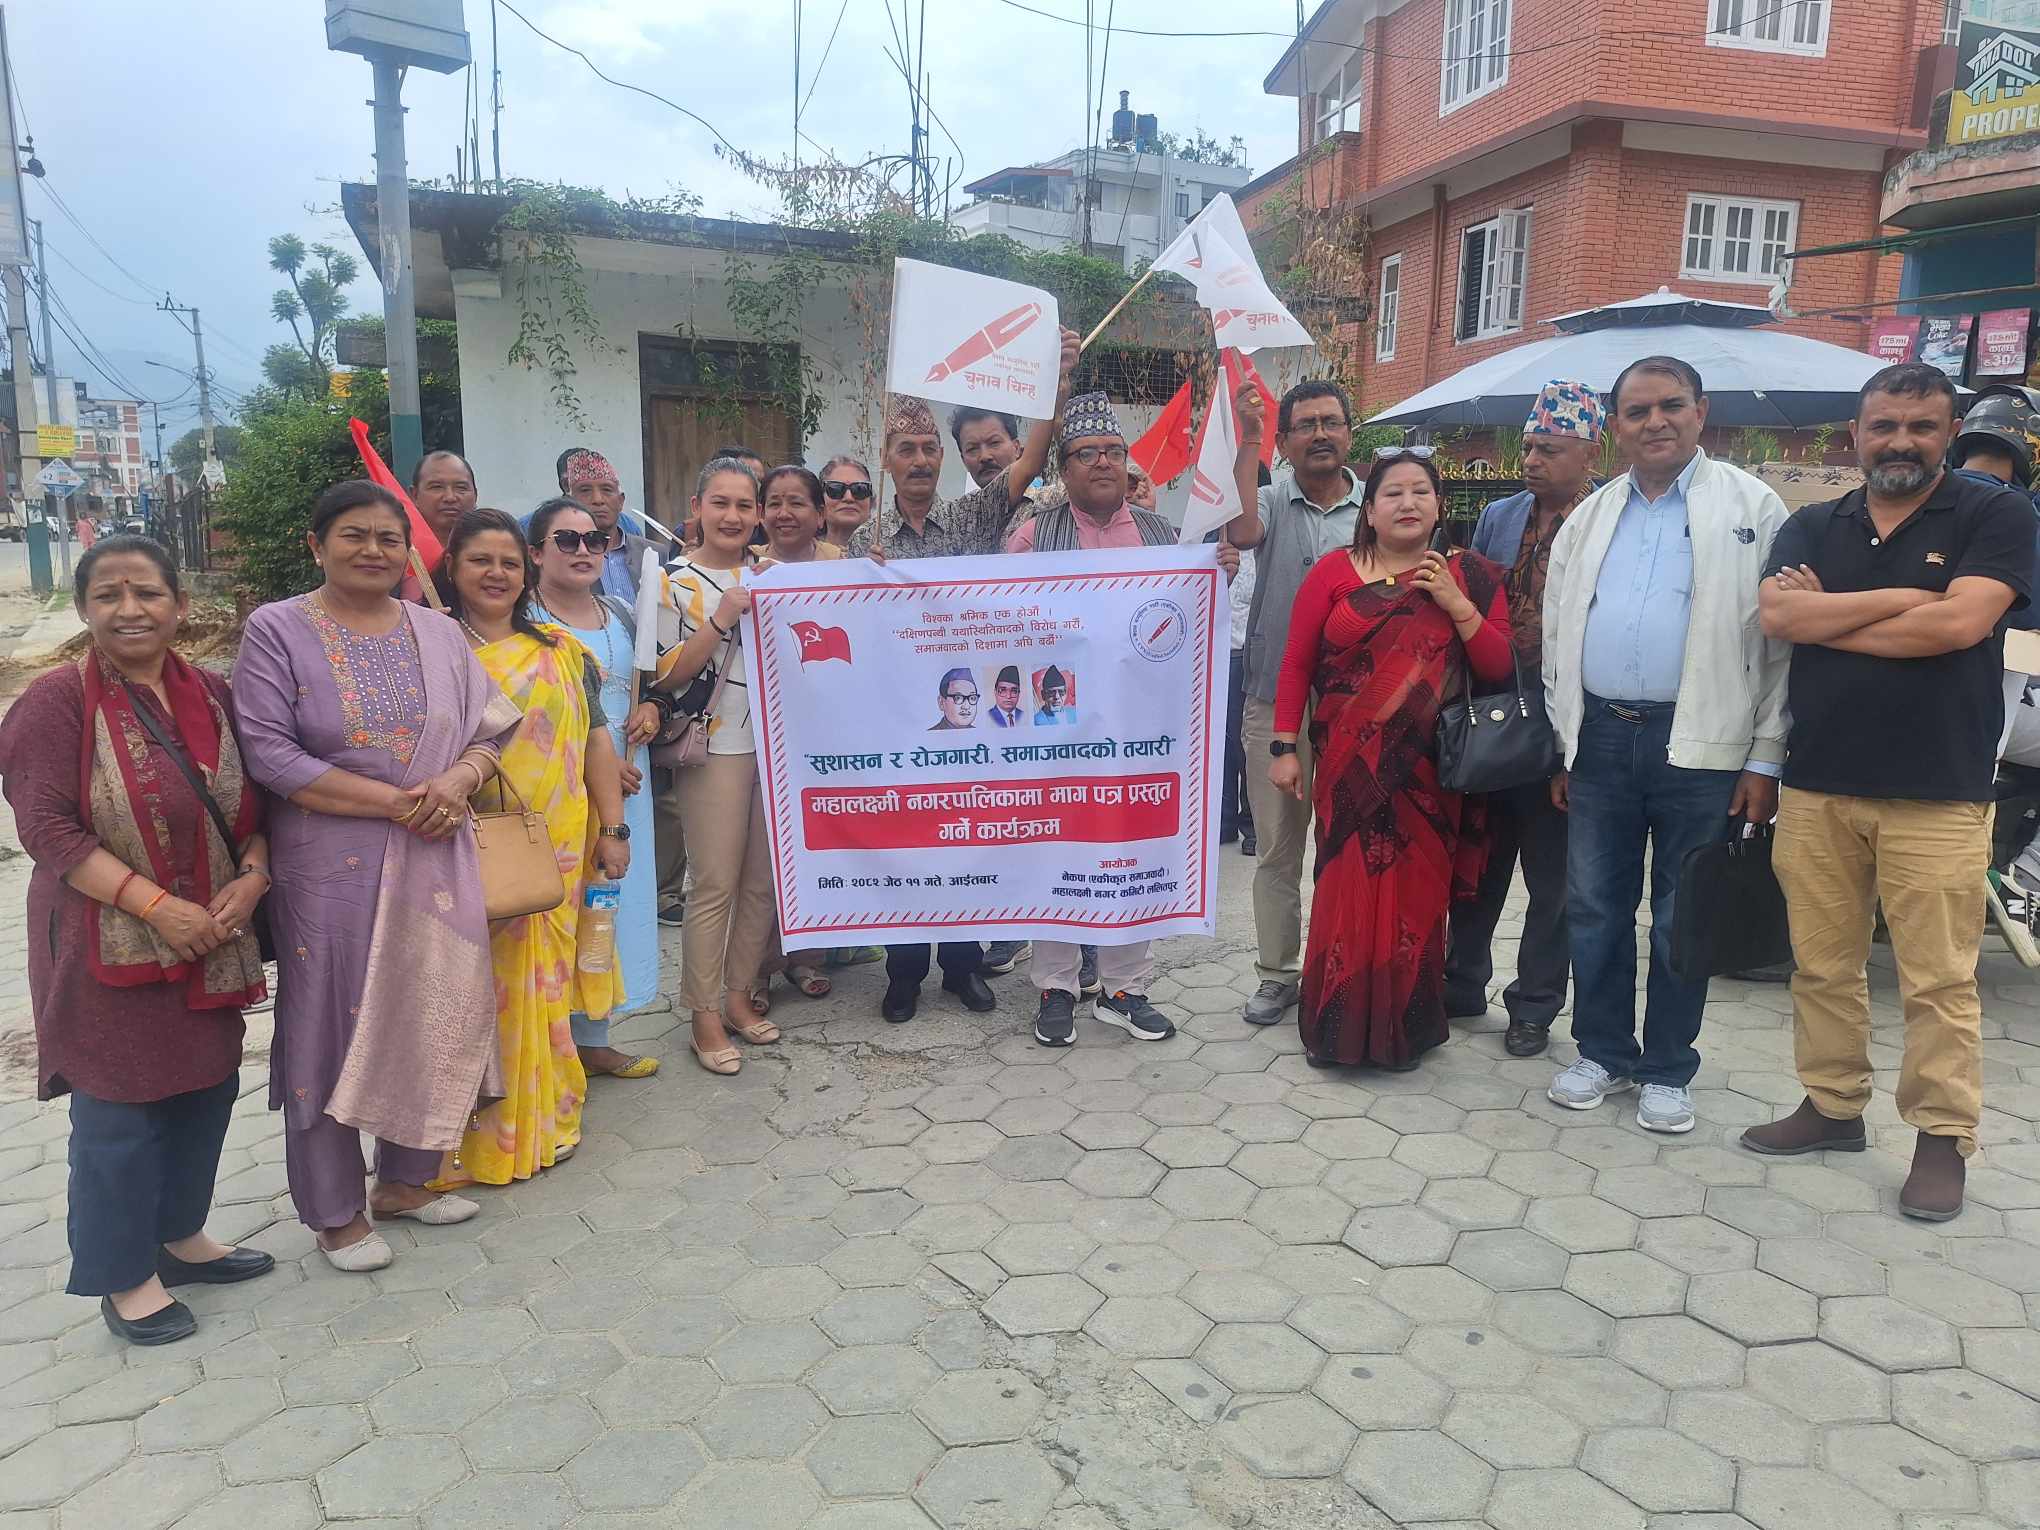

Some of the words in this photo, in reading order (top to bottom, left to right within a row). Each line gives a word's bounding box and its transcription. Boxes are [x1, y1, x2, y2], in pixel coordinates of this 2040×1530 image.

[1974, 42, 2033, 80] IMADOL
[1962, 104, 2040, 139] PROPE
[1247, 312, 1280, 331] चुनाव
[964, 371, 1001, 391] चुनाव
[1007, 375, 1036, 400] चिन्ह
[922, 611, 953, 624] विश्वका
[960, 609, 988, 621] श्रमिक
[995, 609, 1010, 619] एक
[1031, 619, 1057, 632] विरोध
[914, 640, 969, 654] समाजवादको
[975, 638, 1008, 651] दिशामा
[1015, 635, 1033, 648] अघि
[890, 752, 904, 769] र
[1001, 737, 1117, 763] समाजवादको
[811, 789, 900, 815] महालक्ष्मी
[906, 784, 1043, 811] नगरपालिकामा
[1049, 785, 1088, 804] माग
[1093, 784, 1124, 805] पत्र
[1128, 781, 1172, 806] प्रस्तुत
[938, 816, 972, 841] गर्ने
[976, 816, 1061, 840] कार्यक्रम
[1098, 857, 1138, 869] आयोजक
[851, 877, 880, 888] २०८२
[883, 875, 902, 888] जेठ
[905, 877, 920, 887] ११
[948, 874, 999, 887] आईतबार
[1062, 871, 1086, 883] नेकपा
[1051, 885, 1091, 898] महालक्ष्मी
[1094, 889, 1117, 900] नगर
[1120, 884, 1145, 898] कमिटी
[1147, 880, 1178, 894] ललितपुर
